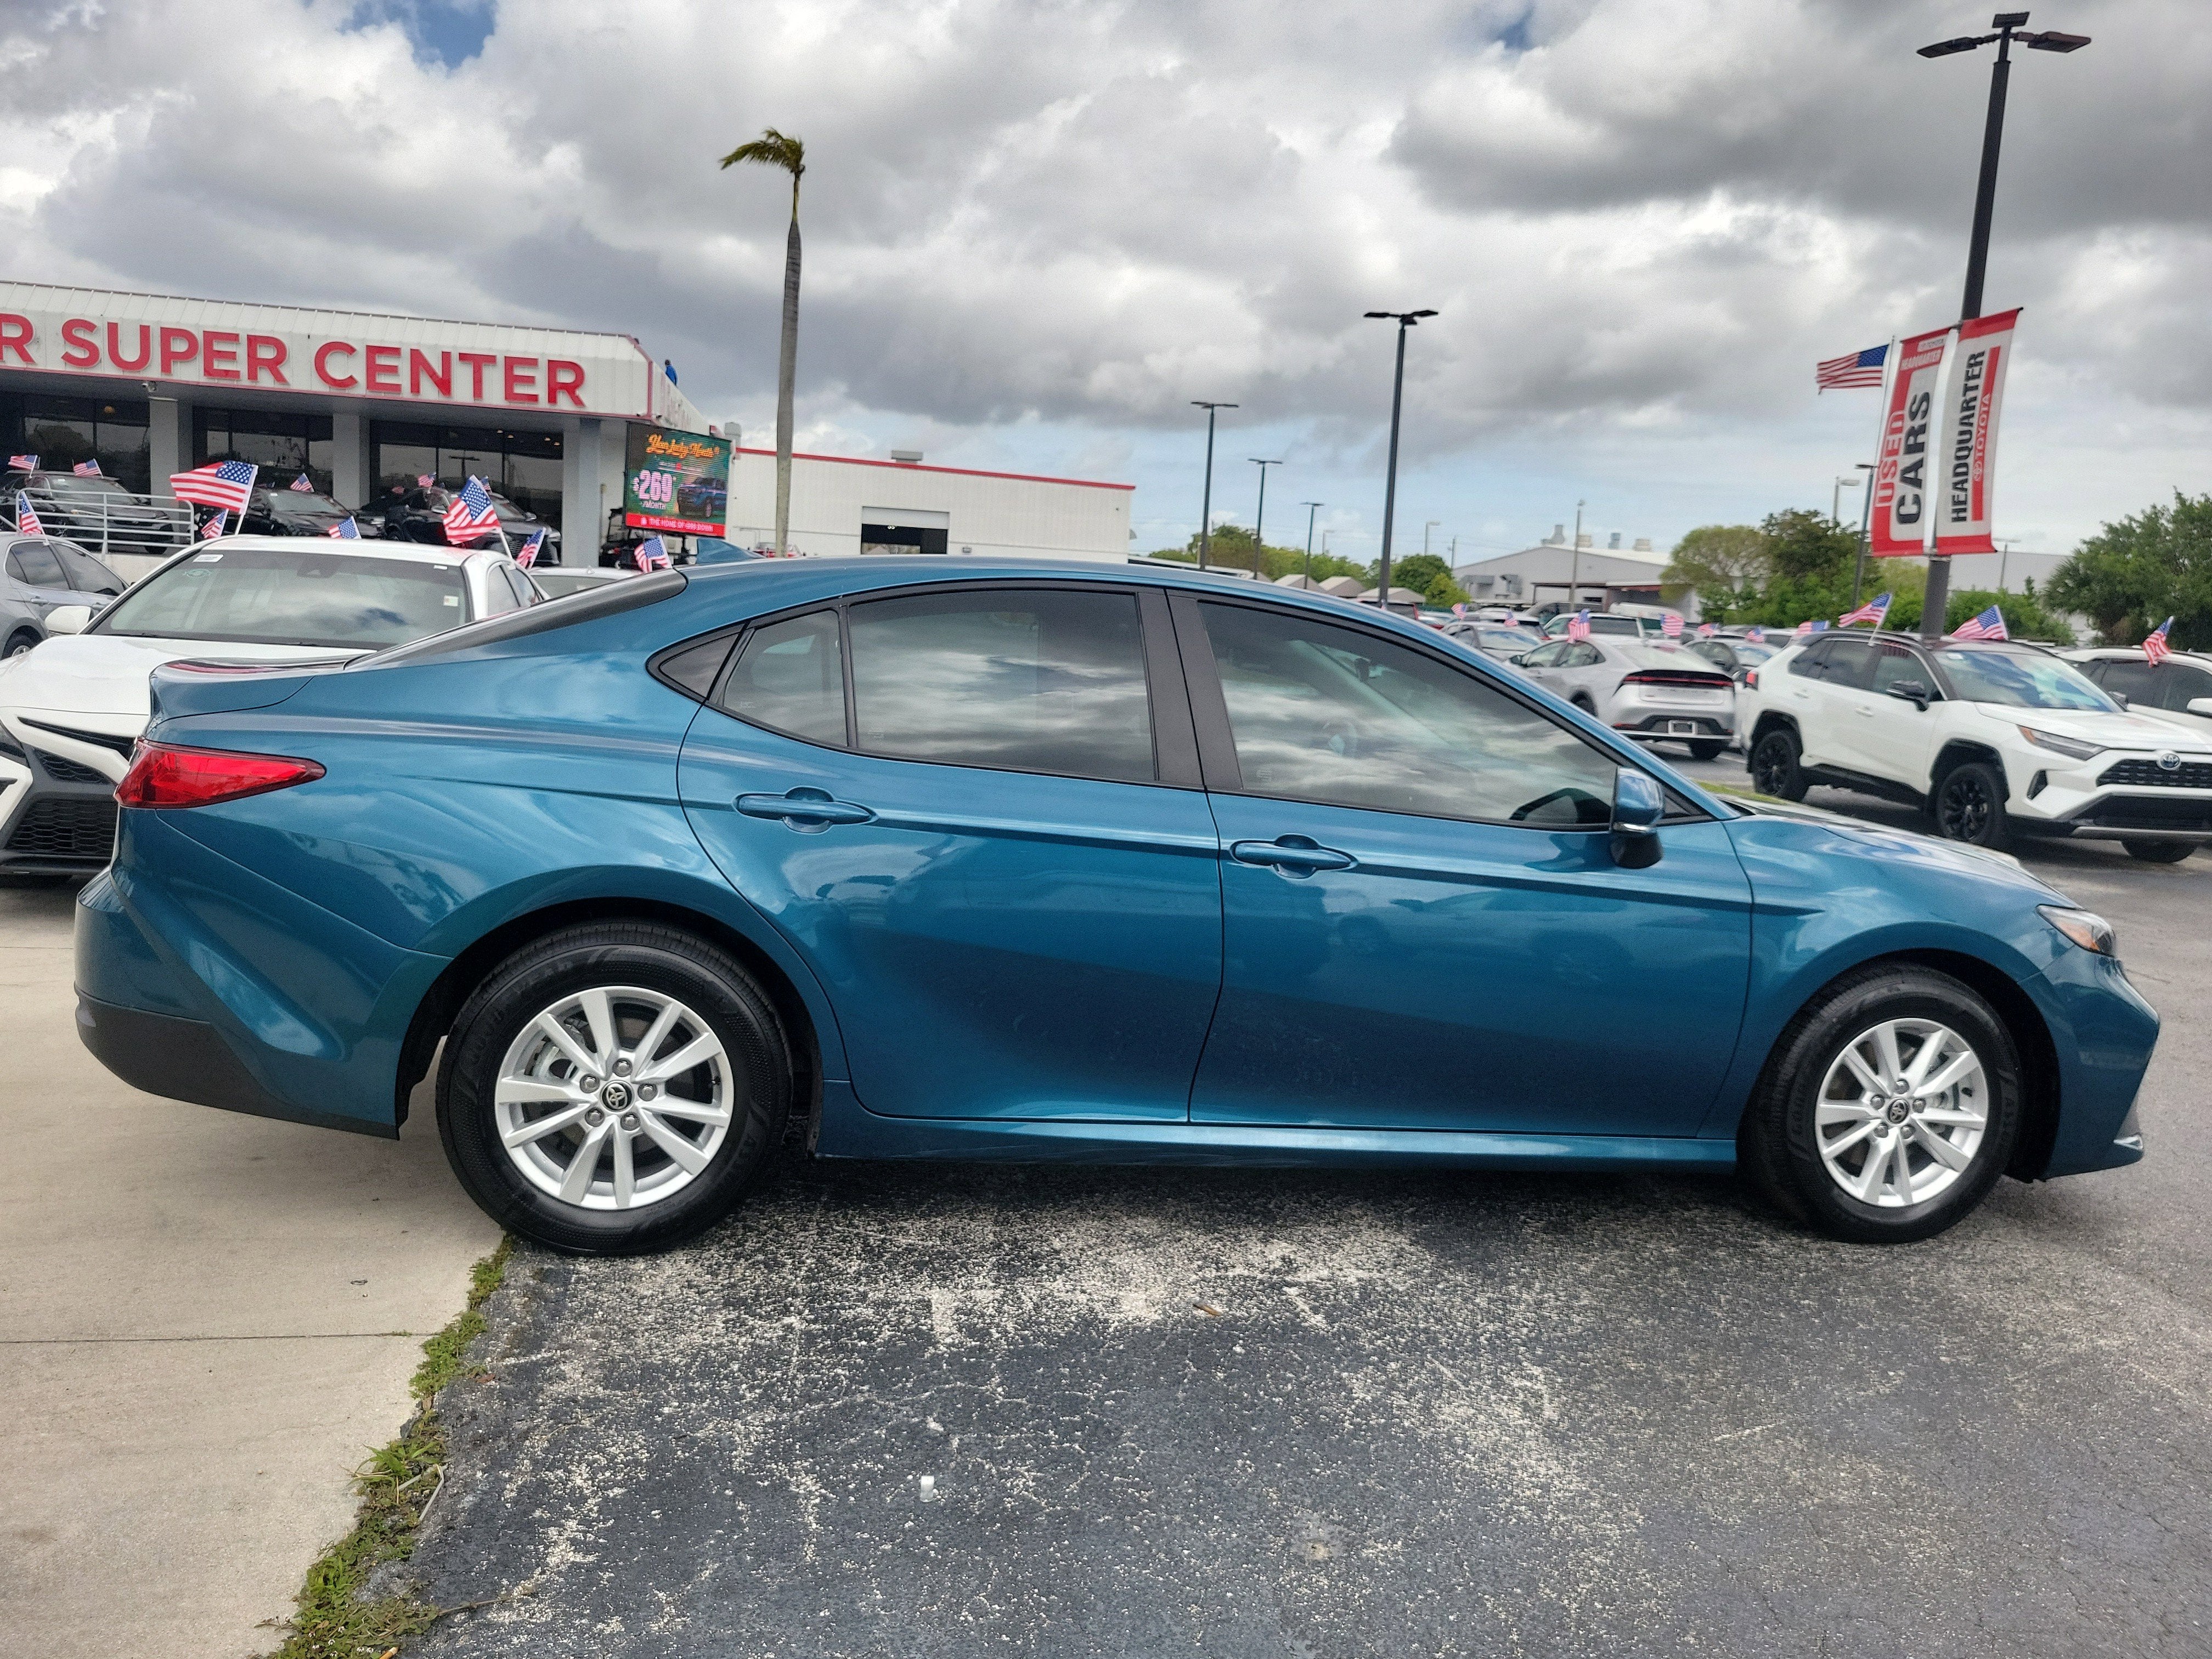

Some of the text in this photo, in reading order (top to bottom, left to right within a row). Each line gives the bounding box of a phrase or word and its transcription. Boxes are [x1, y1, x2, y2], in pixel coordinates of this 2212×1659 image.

[61, 318, 288, 384] SUPER
[314, 342, 586, 407] CENTER
[1874, 410, 1905, 507] USED
[1896, 392, 1929, 524] CARS
[1951, 350, 1985, 522] HEADQUARTER
[1975, 393, 1991, 456] TOYOTA
